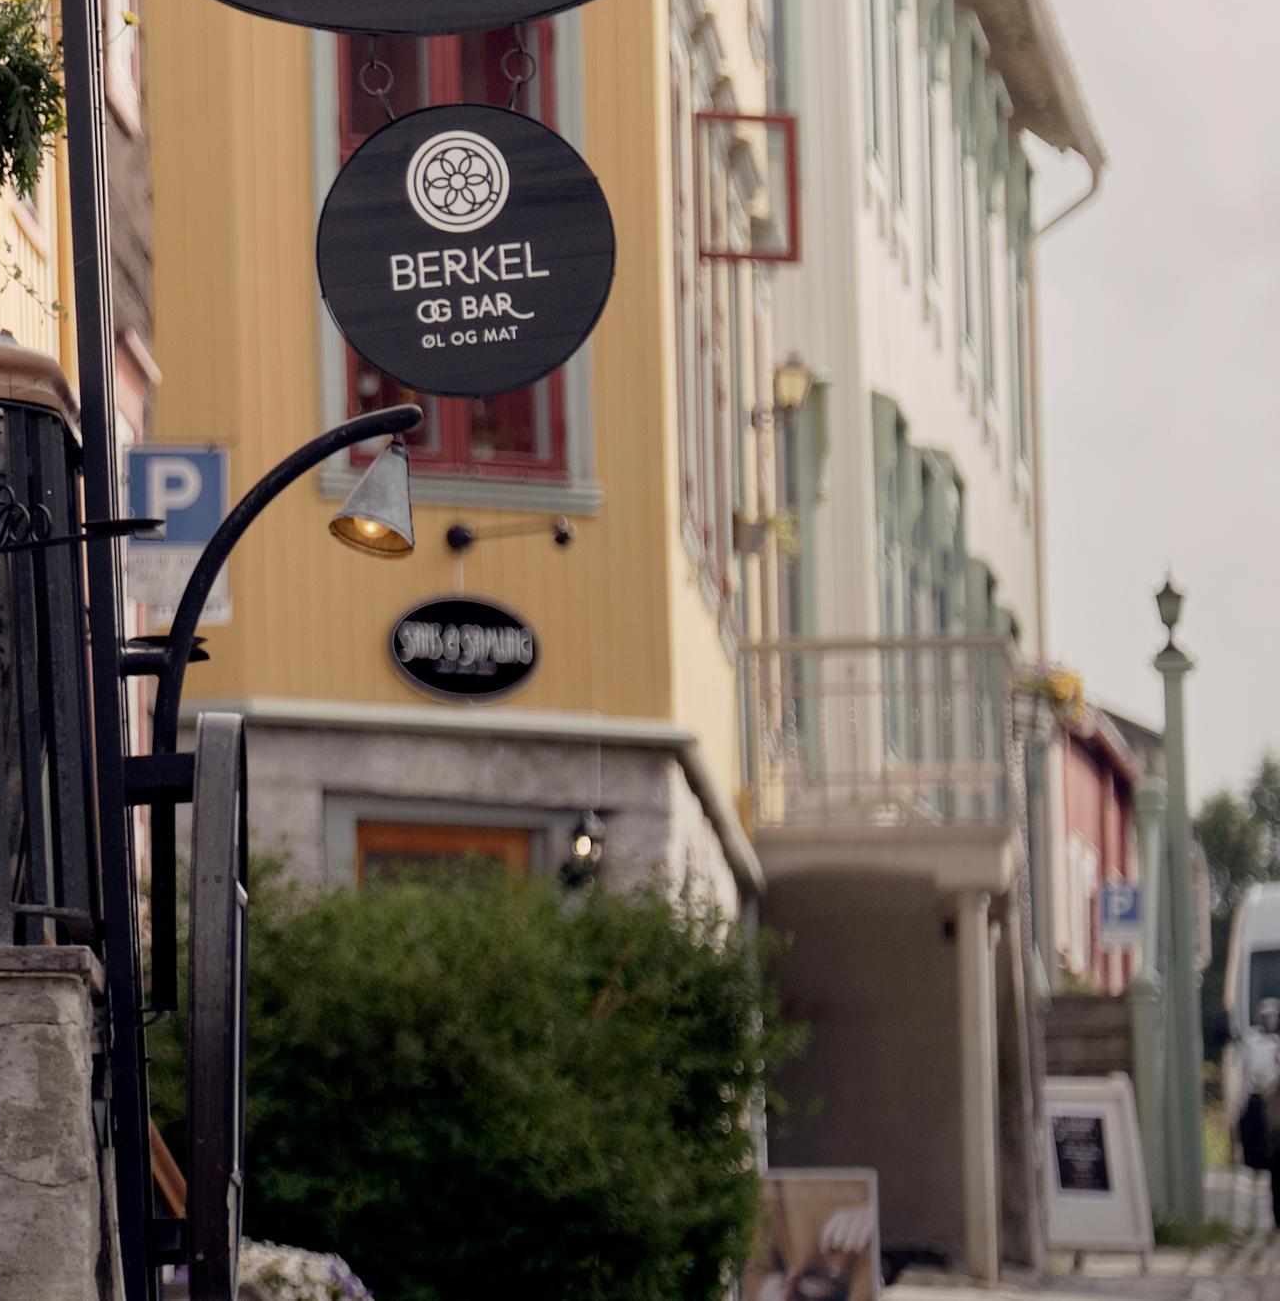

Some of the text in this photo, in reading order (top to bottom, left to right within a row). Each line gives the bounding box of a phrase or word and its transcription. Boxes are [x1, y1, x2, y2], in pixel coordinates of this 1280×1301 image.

[390, 241, 550, 291] BERKEL
[416, 292, 536, 324] OG BAR
[421, 325, 519, 349] ØL OG MAT
[146, 456, 202, 538] P
